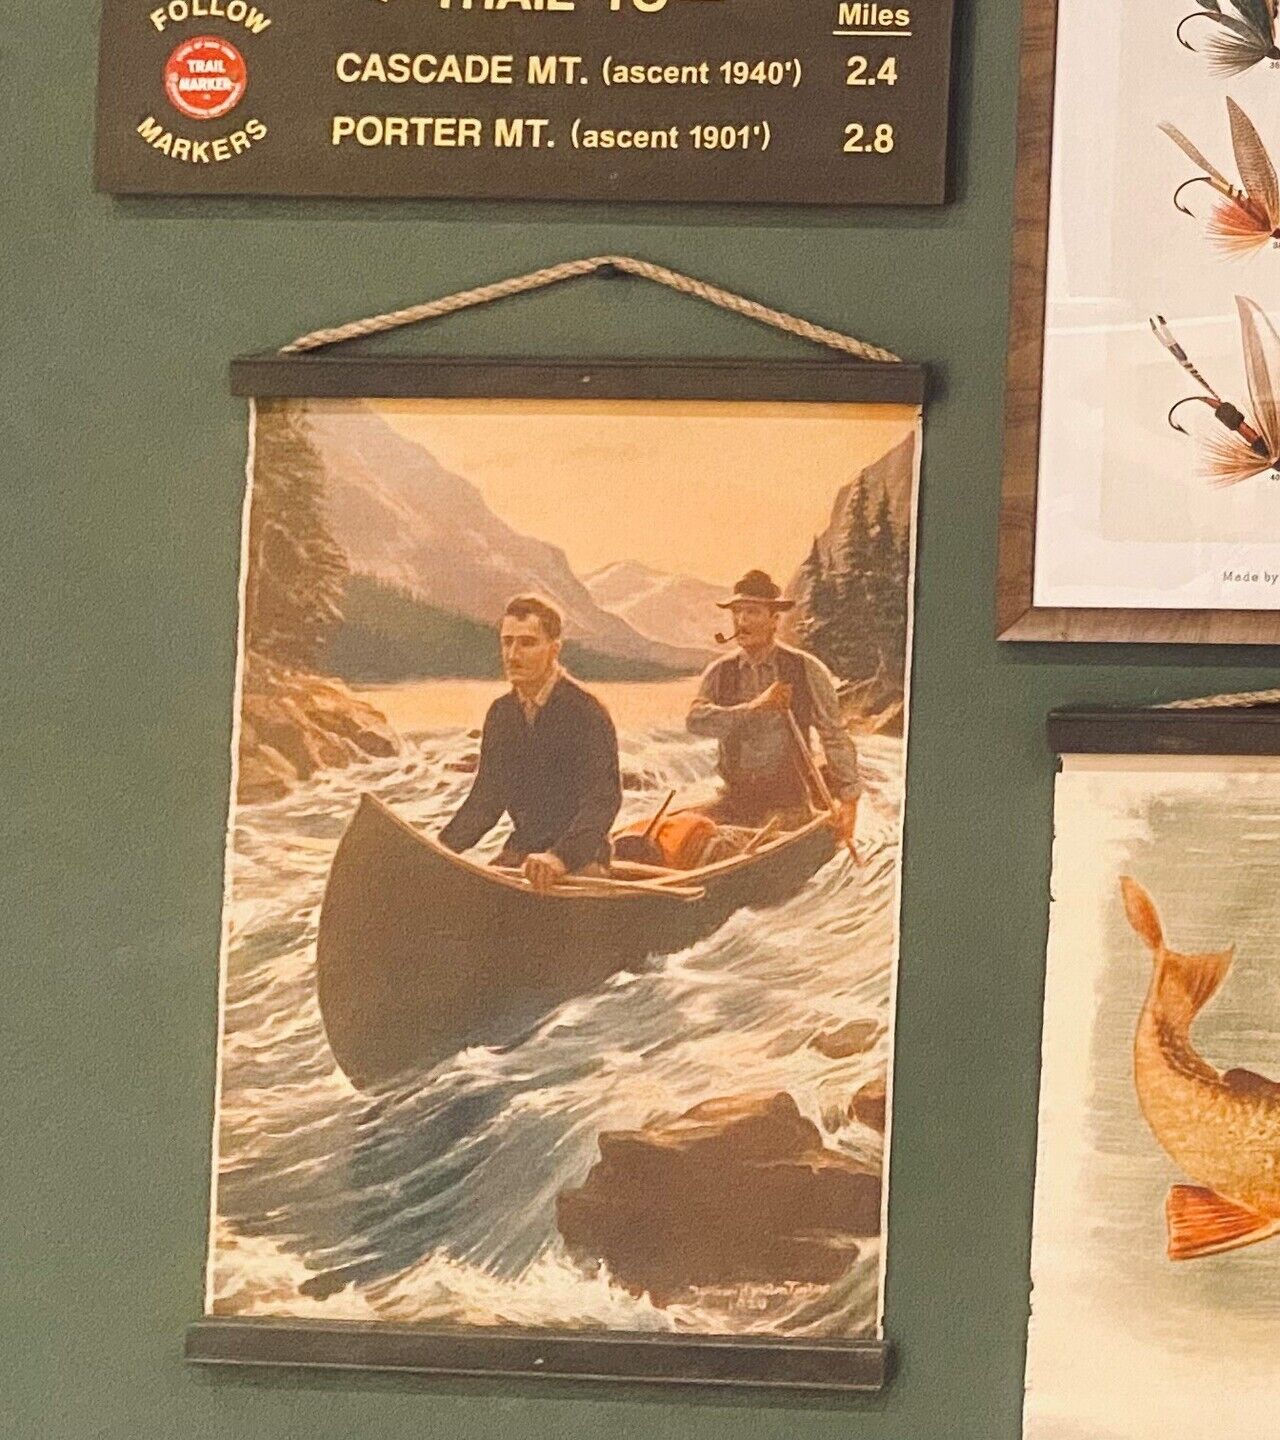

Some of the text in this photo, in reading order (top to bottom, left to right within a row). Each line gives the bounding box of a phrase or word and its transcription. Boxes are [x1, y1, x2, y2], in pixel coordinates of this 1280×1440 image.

[838, 2, 911, 28] Miles
[187, 59, 227, 74] TRAIL
[335, 52, 899, 88] CASCADE MT. (ascent 1940') 2.4
[179, 76, 232, 92] MARKER
[136, 115, 269, 165] MARKERS
[331, 115, 895, 154] PORTER MT. (ascent 1901') 2.8
[1222, 571, 1259, 583] Made
[1263, 571, 1280, 585] by
